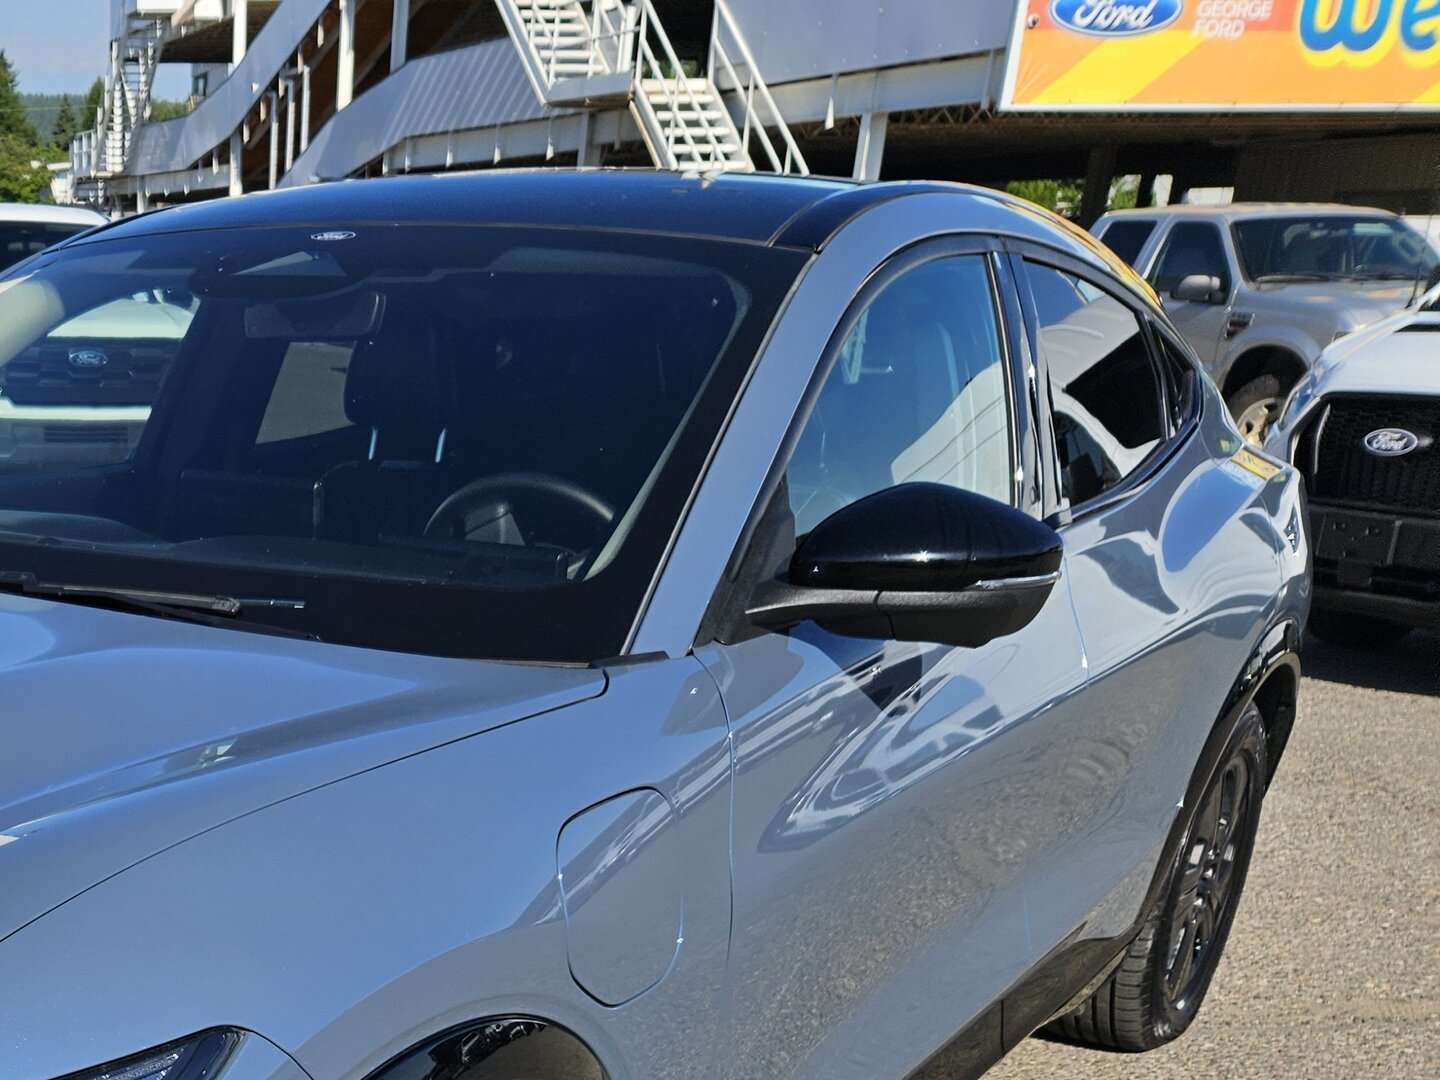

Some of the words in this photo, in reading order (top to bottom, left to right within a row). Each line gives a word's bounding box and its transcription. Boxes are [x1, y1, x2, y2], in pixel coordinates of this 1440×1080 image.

[1072, 0, 1155, 30] Ford
[1195, 0, 1274, 20] GEORGE
[1192, 20, 1246, 39] FORD
